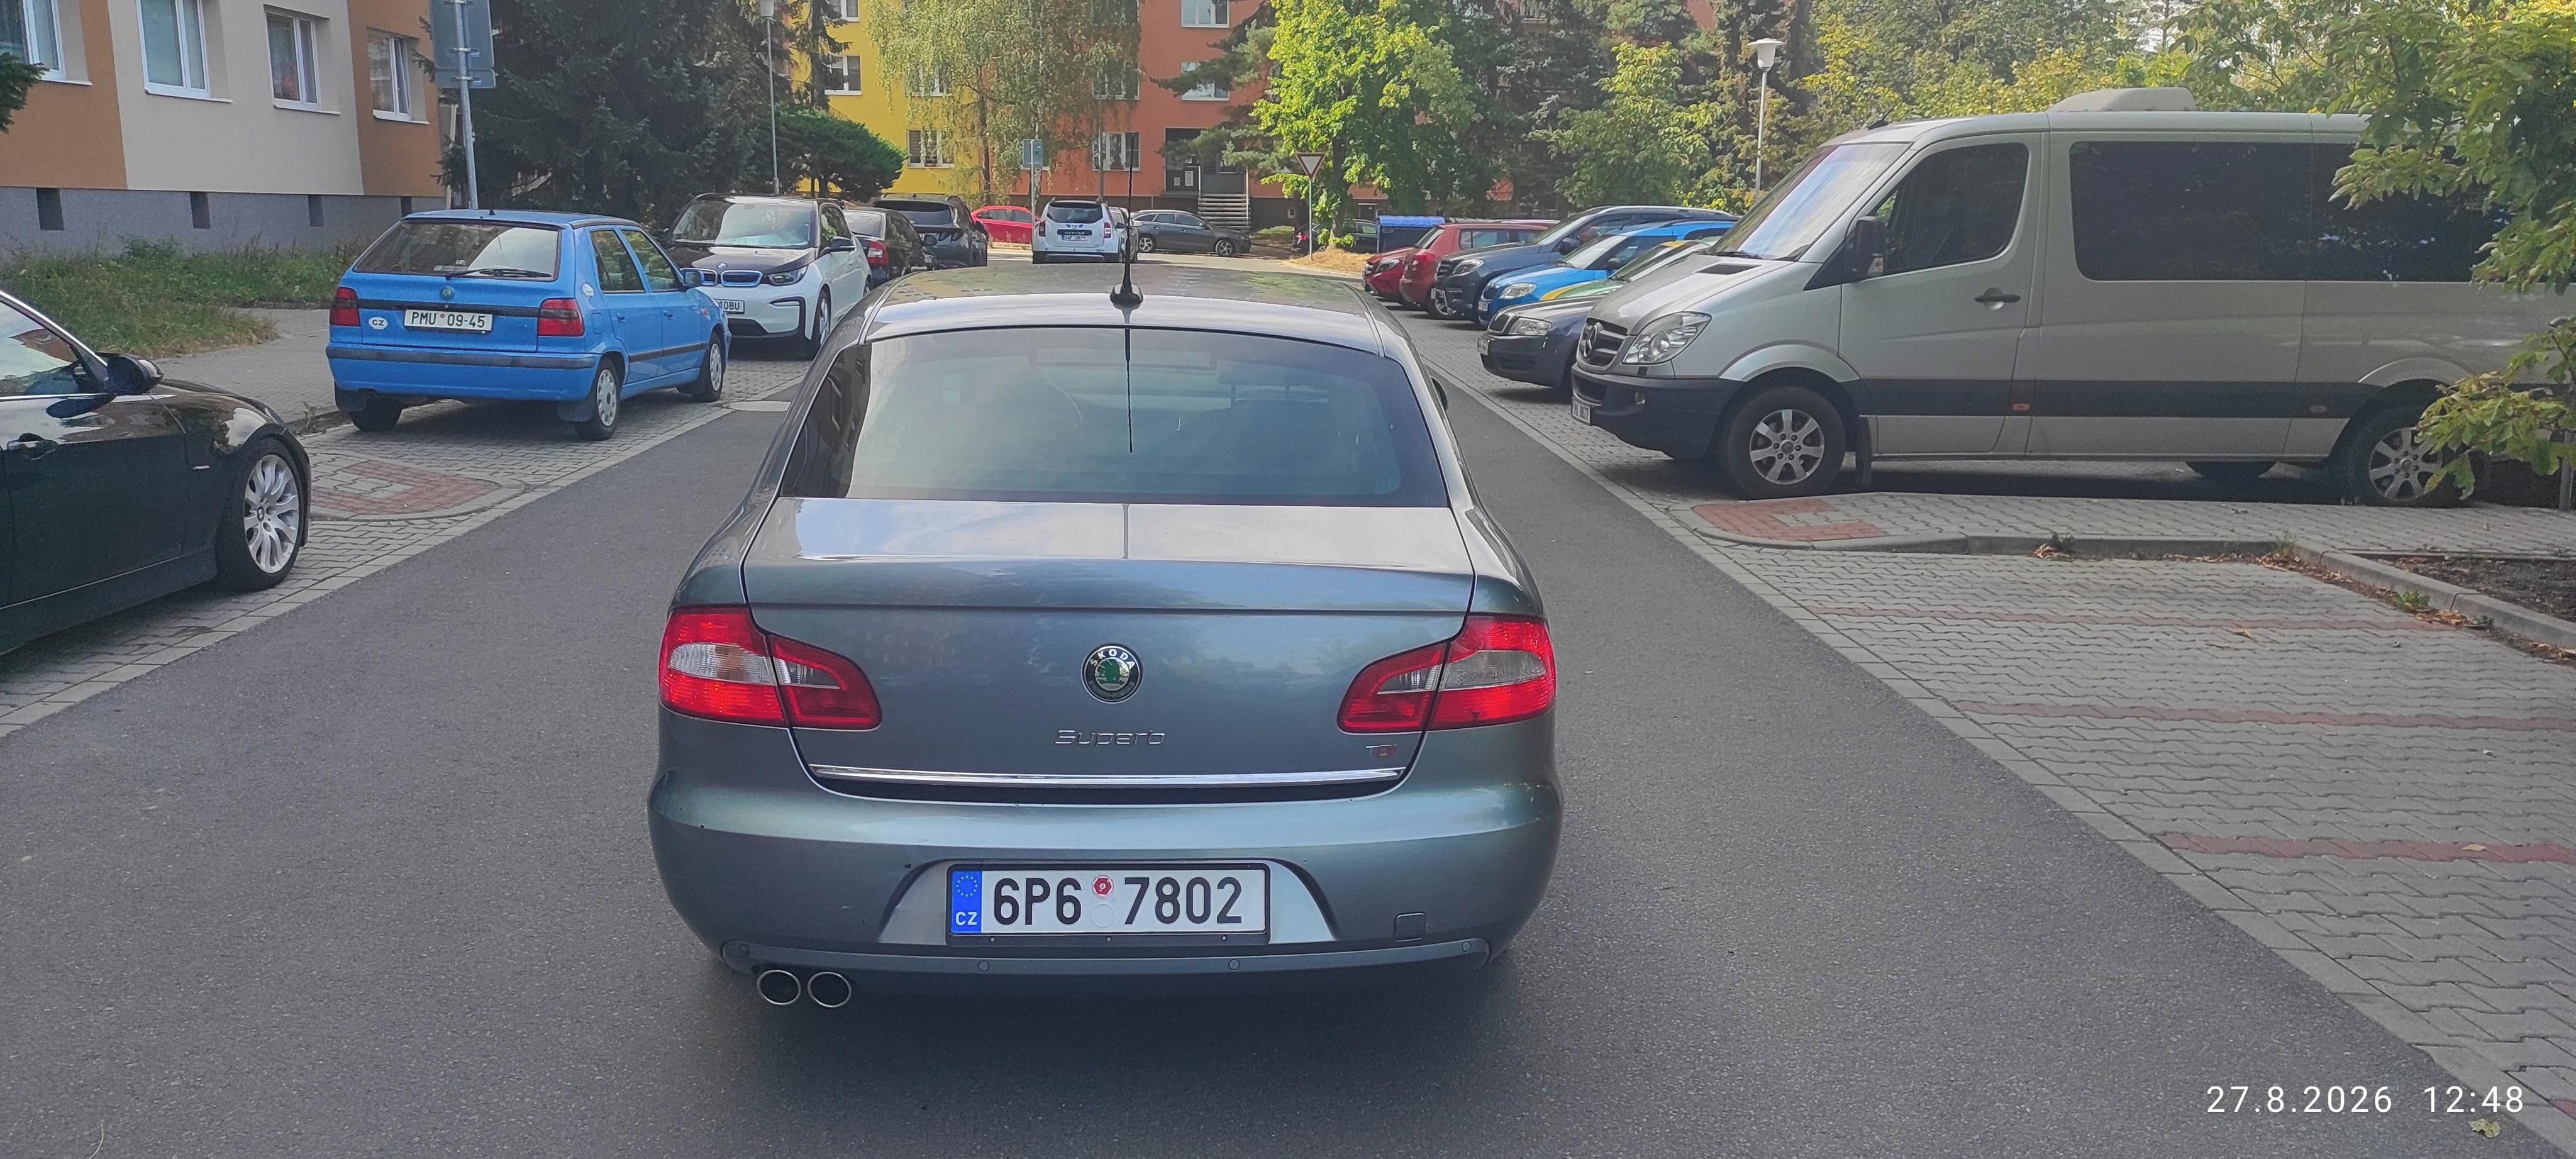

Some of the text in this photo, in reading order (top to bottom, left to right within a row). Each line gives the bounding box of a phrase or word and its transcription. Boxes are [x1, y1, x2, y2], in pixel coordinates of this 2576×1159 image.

[411, 312, 486, 328] PMU 09-45
[1054, 728, 1167, 747] Superb
[993, 877, 1242, 926] 6P6 7802
[955, 911, 978, 926] CZ
